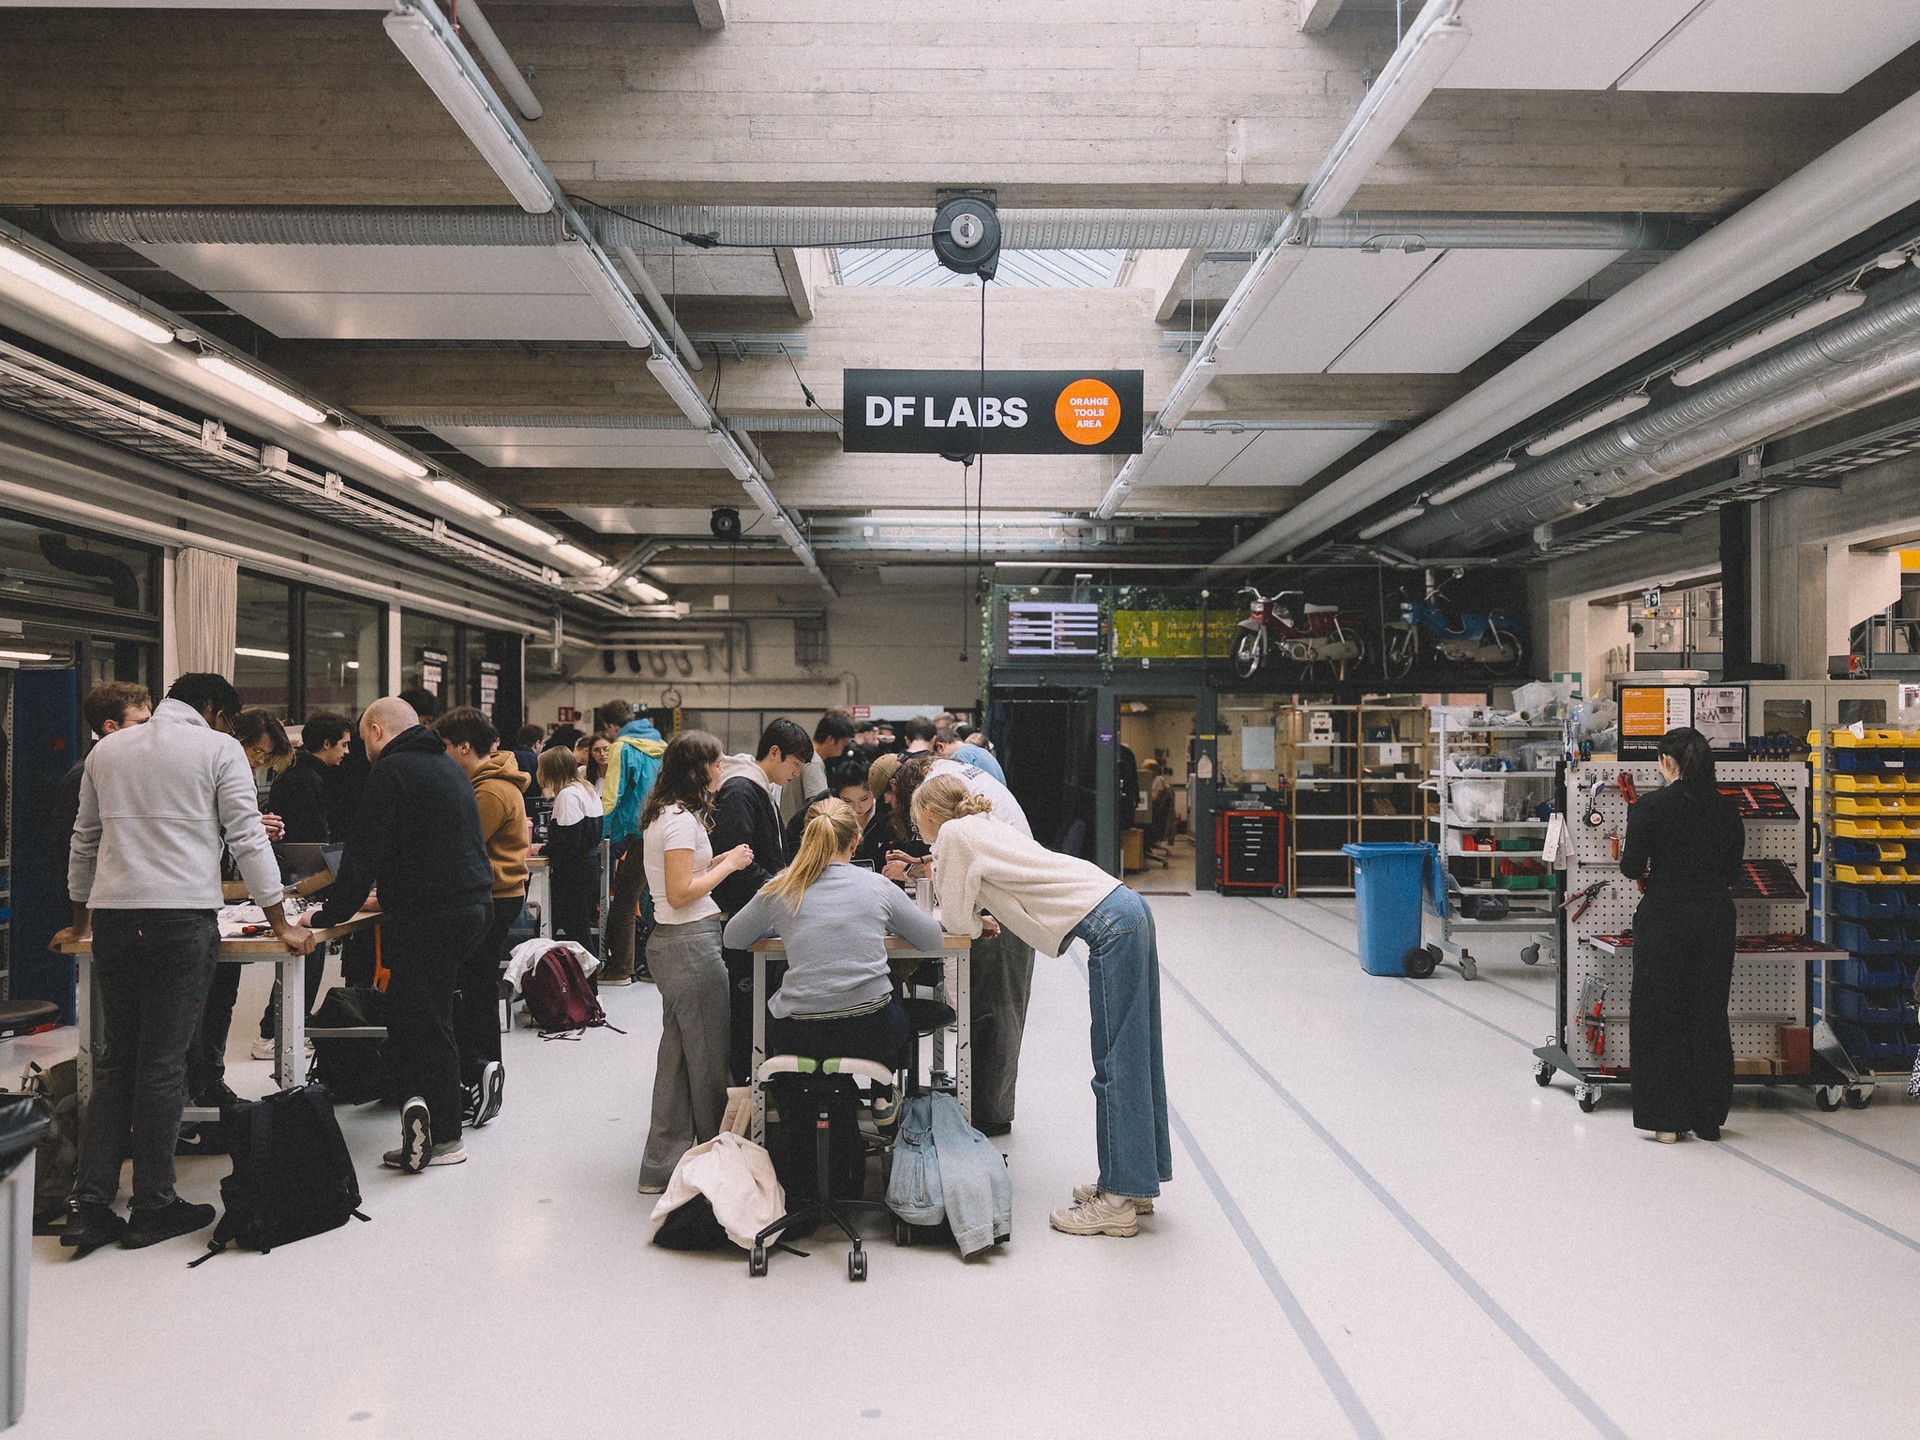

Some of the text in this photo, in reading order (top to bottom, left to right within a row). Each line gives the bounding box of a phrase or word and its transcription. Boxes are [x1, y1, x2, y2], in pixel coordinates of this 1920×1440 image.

[1069, 397, 1109, 406] ORANGE
[866, 396, 1028, 428] DF LABS
[1074, 408, 1105, 417] TOOLS
[1076, 419, 1102, 428] AREA
